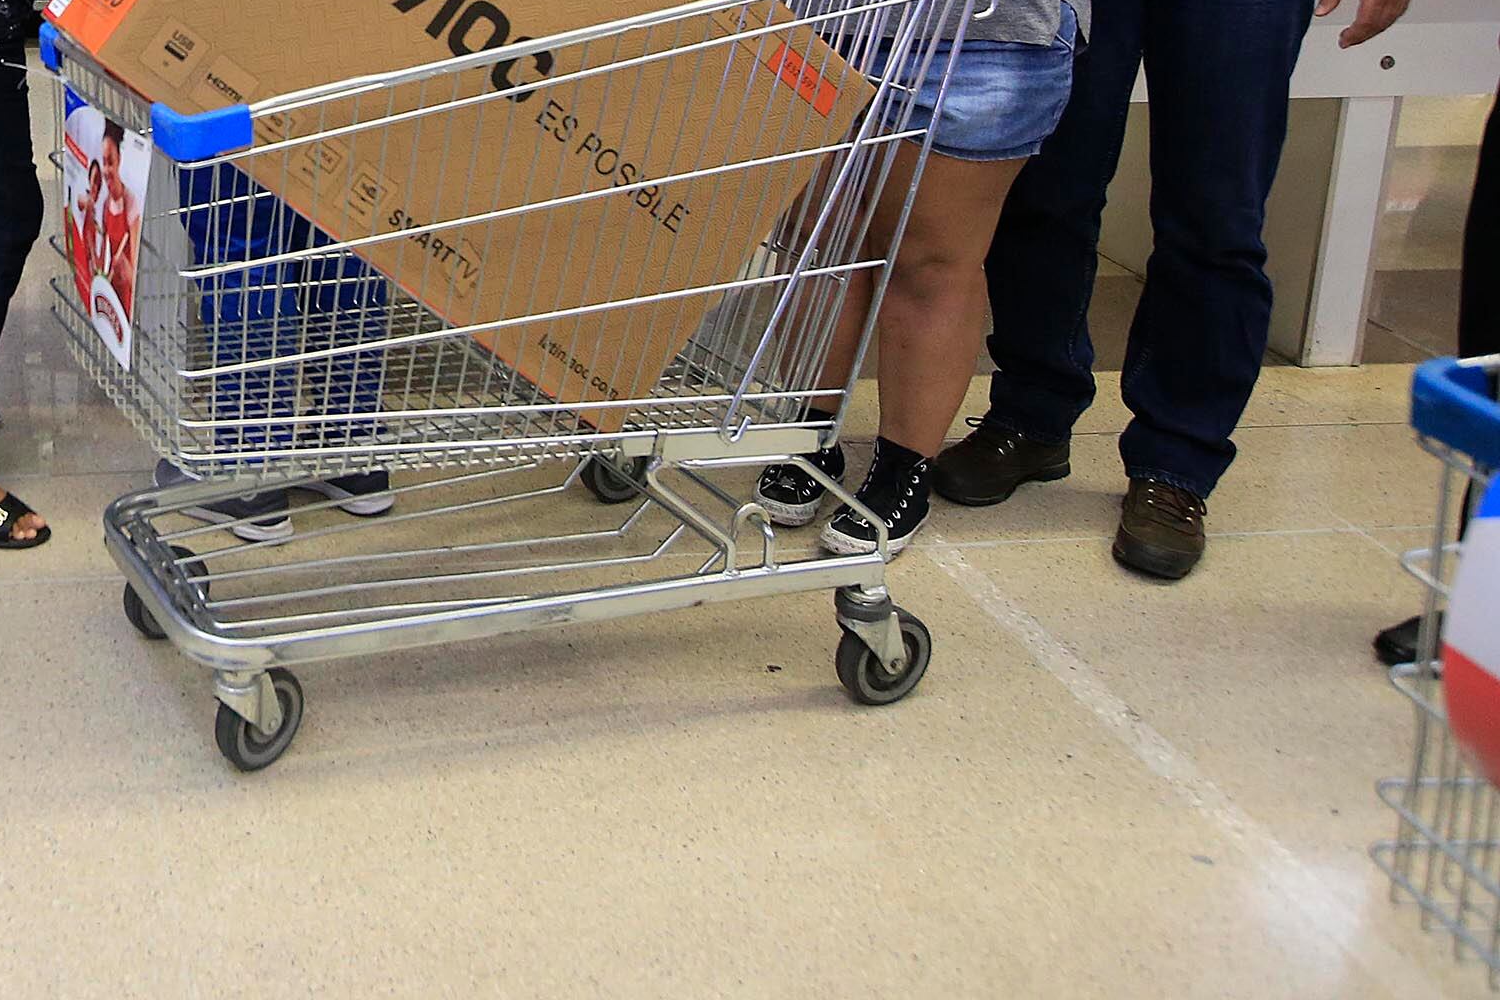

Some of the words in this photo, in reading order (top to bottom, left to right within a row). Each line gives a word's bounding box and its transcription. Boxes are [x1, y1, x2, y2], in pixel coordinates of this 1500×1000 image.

[171, 29, 196, 52] USB
[205, 71, 244, 103] HDMI
[535, 98, 579, 143] ES
[575, 127, 691, 234] POSIBLE
